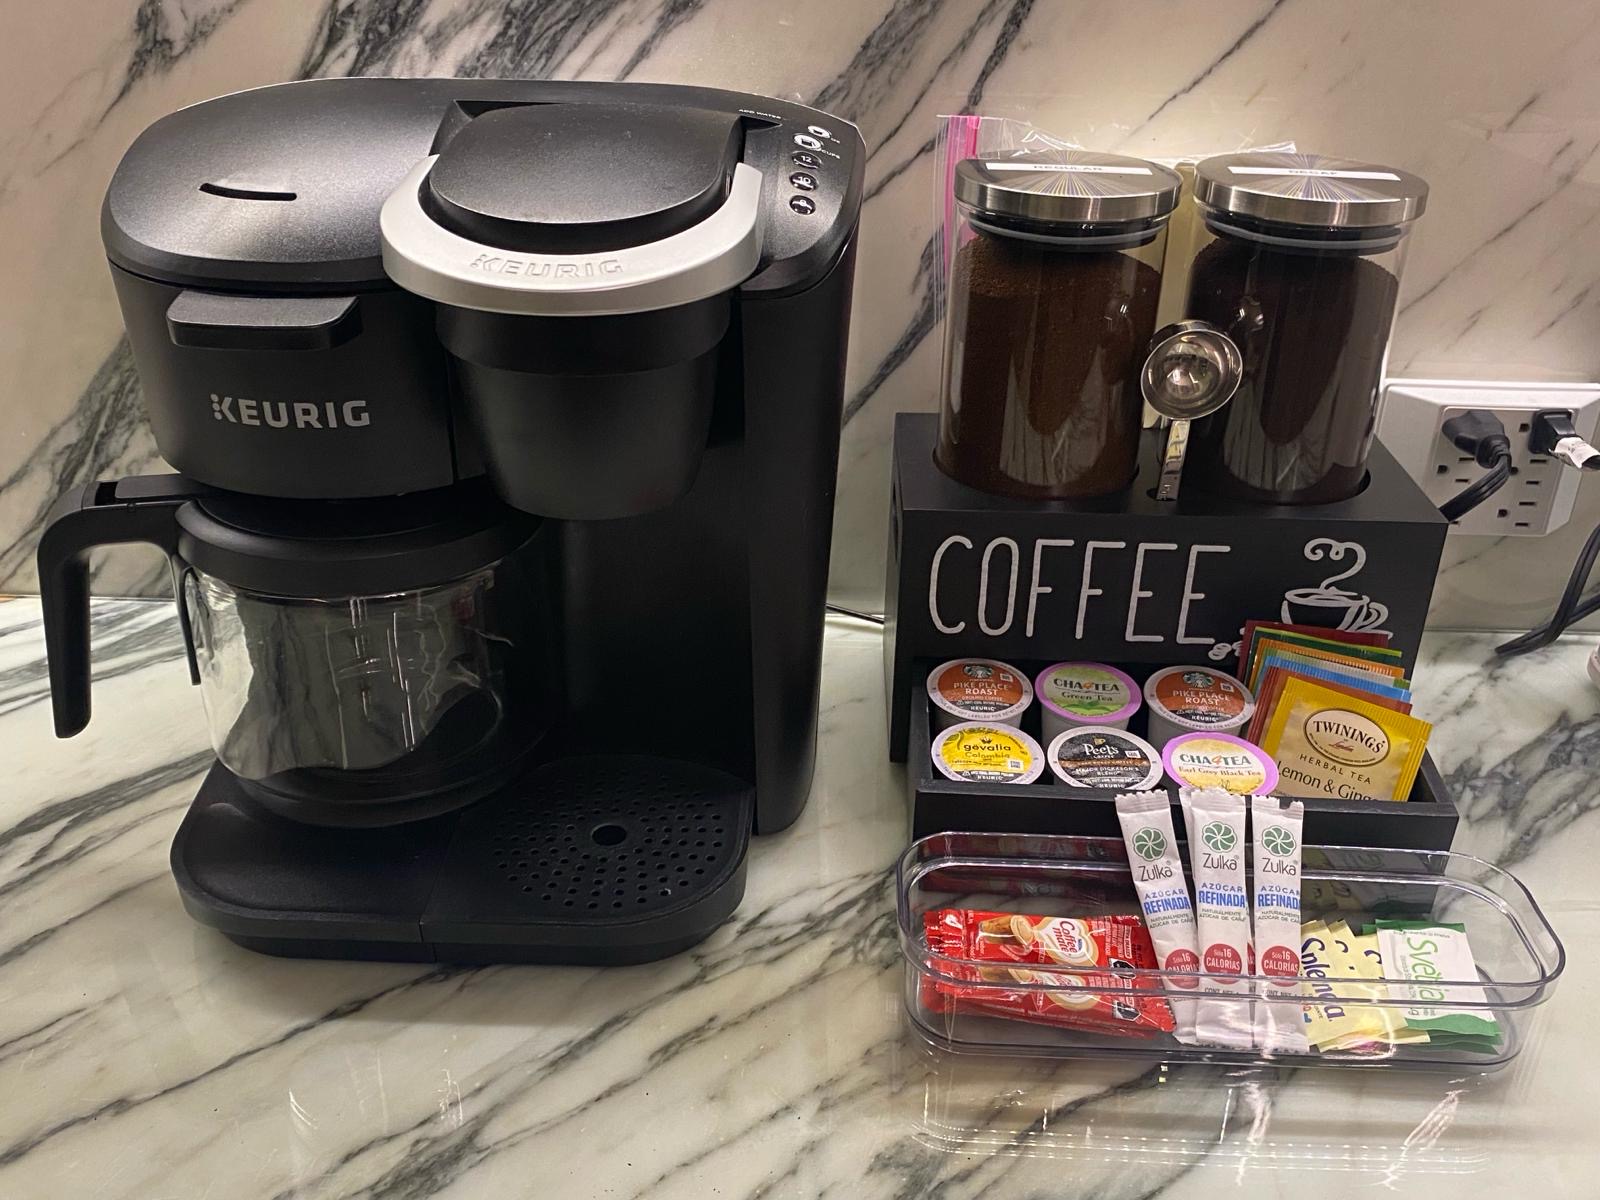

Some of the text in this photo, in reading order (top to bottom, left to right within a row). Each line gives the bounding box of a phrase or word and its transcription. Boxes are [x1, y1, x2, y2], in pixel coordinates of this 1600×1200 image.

[800, 155, 813, 164] 12
[470, 253, 625, 280] KEURIG
[210, 393, 371, 430] KEURIG
[929, 534, 1232, 646] COFFEE
[965, 688, 998, 696] ROAST
[978, 682, 1009, 691] PLACE
[1061, 691, 1092, 701] Green
[1185, 697, 1219, 706] ROAST
[1198, 691, 1231, 702] PLACE
[1313, 720, 1384, 754] TWININGS
[1299, 753, 1372, 785] HERBAL TEA
[1323, 779, 1335, 794] &
[1338, 784, 1377, 800] Gin
[1202, 852, 1238, 871] Zulka
[1261, 857, 1297, 876] Zulka
[1138, 864, 1173, 882] Zulka
[1144, 888, 1185, 900] AZÚCAR
[1201, 882, 1243, 893] AZÚCAR
[1143, 896, 1191, 916] REFINADA
[1198, 890, 1246, 908] REFINADA
[1257, 893, 1300, 910] REFINAD
[1052, 927, 1069, 953] mate
[1059, 920, 1078, 953] Coffee
[1182, 952, 1191, 962] 16
[1223, 948, 1232, 958] 16
[1282, 950, 1291, 961] 16
[1206, 956, 1241, 970] CALORÍAS
[1263, 959, 1299, 973] CALORÍAS
